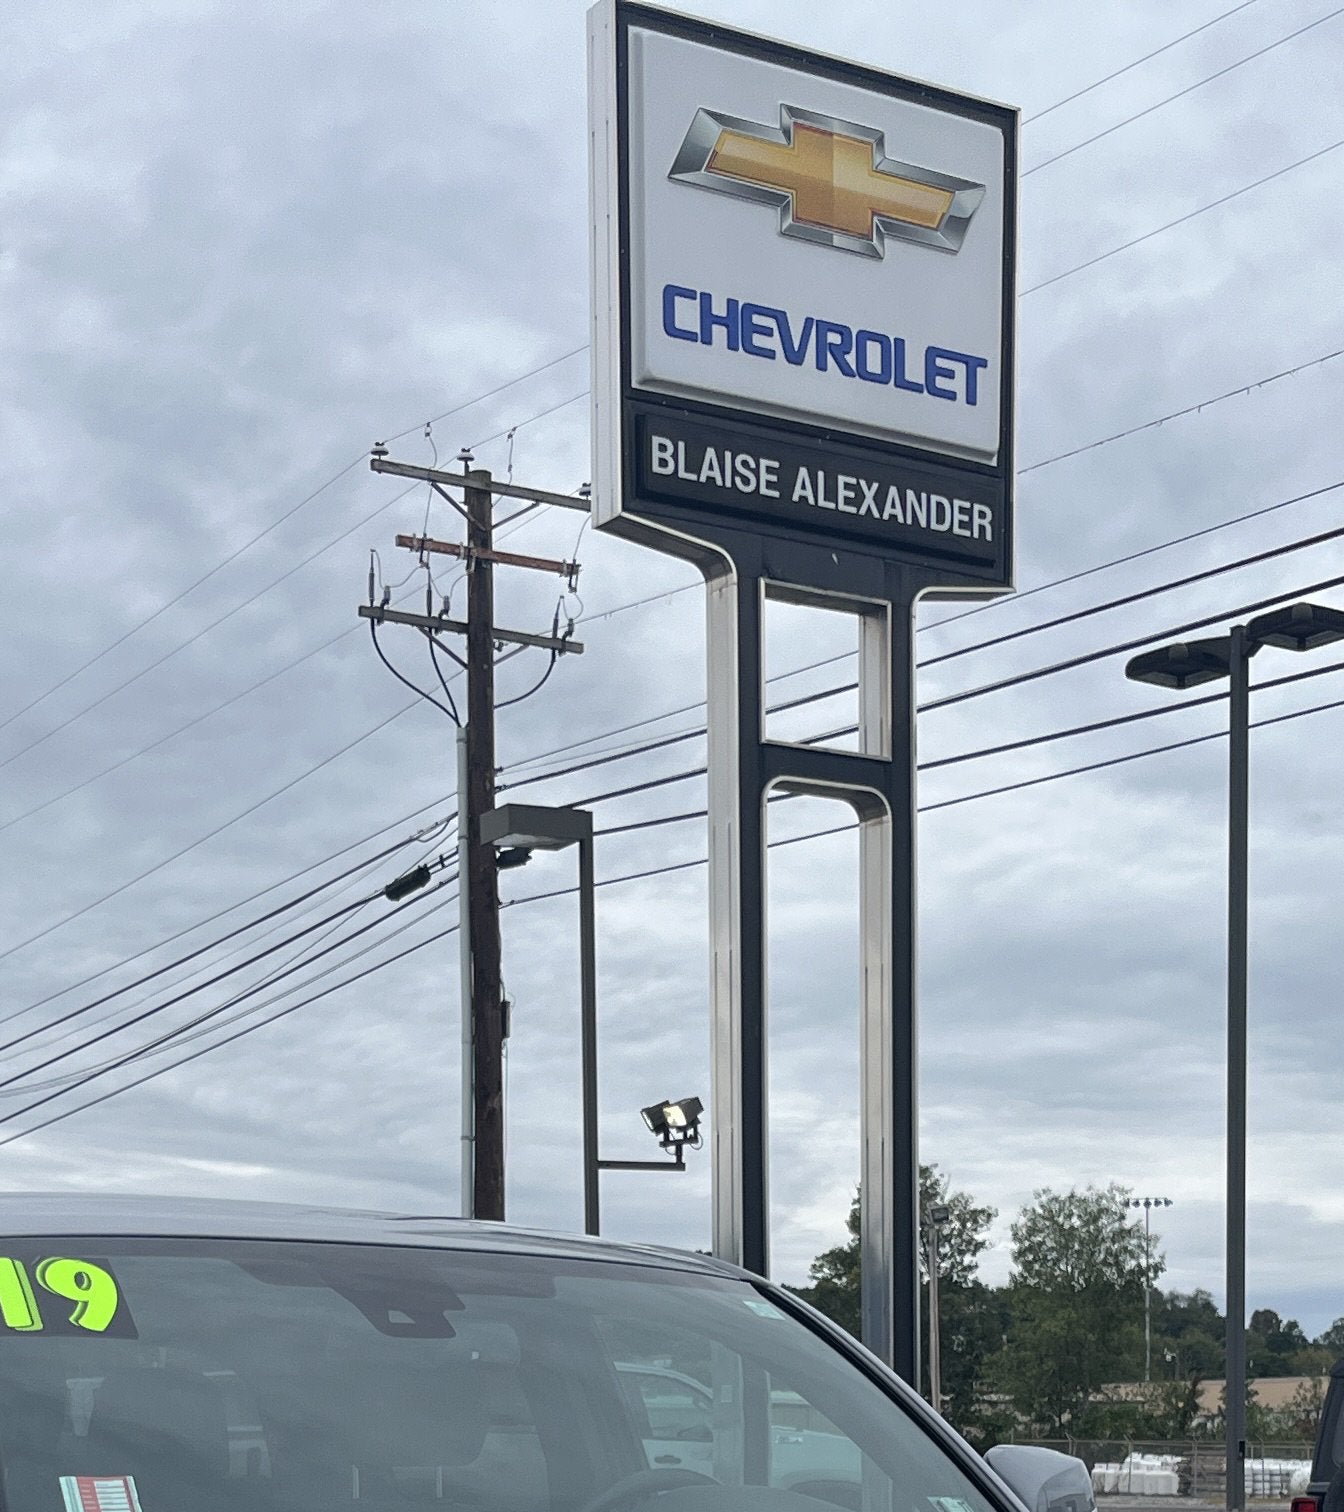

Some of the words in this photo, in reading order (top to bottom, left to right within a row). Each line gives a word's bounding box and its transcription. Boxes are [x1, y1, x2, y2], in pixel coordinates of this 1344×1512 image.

[662, 284, 988, 405] CHEVROLET
[651, 435, 780, 498] BLAISE
[792, 467, 993, 541] ALEXANDER
